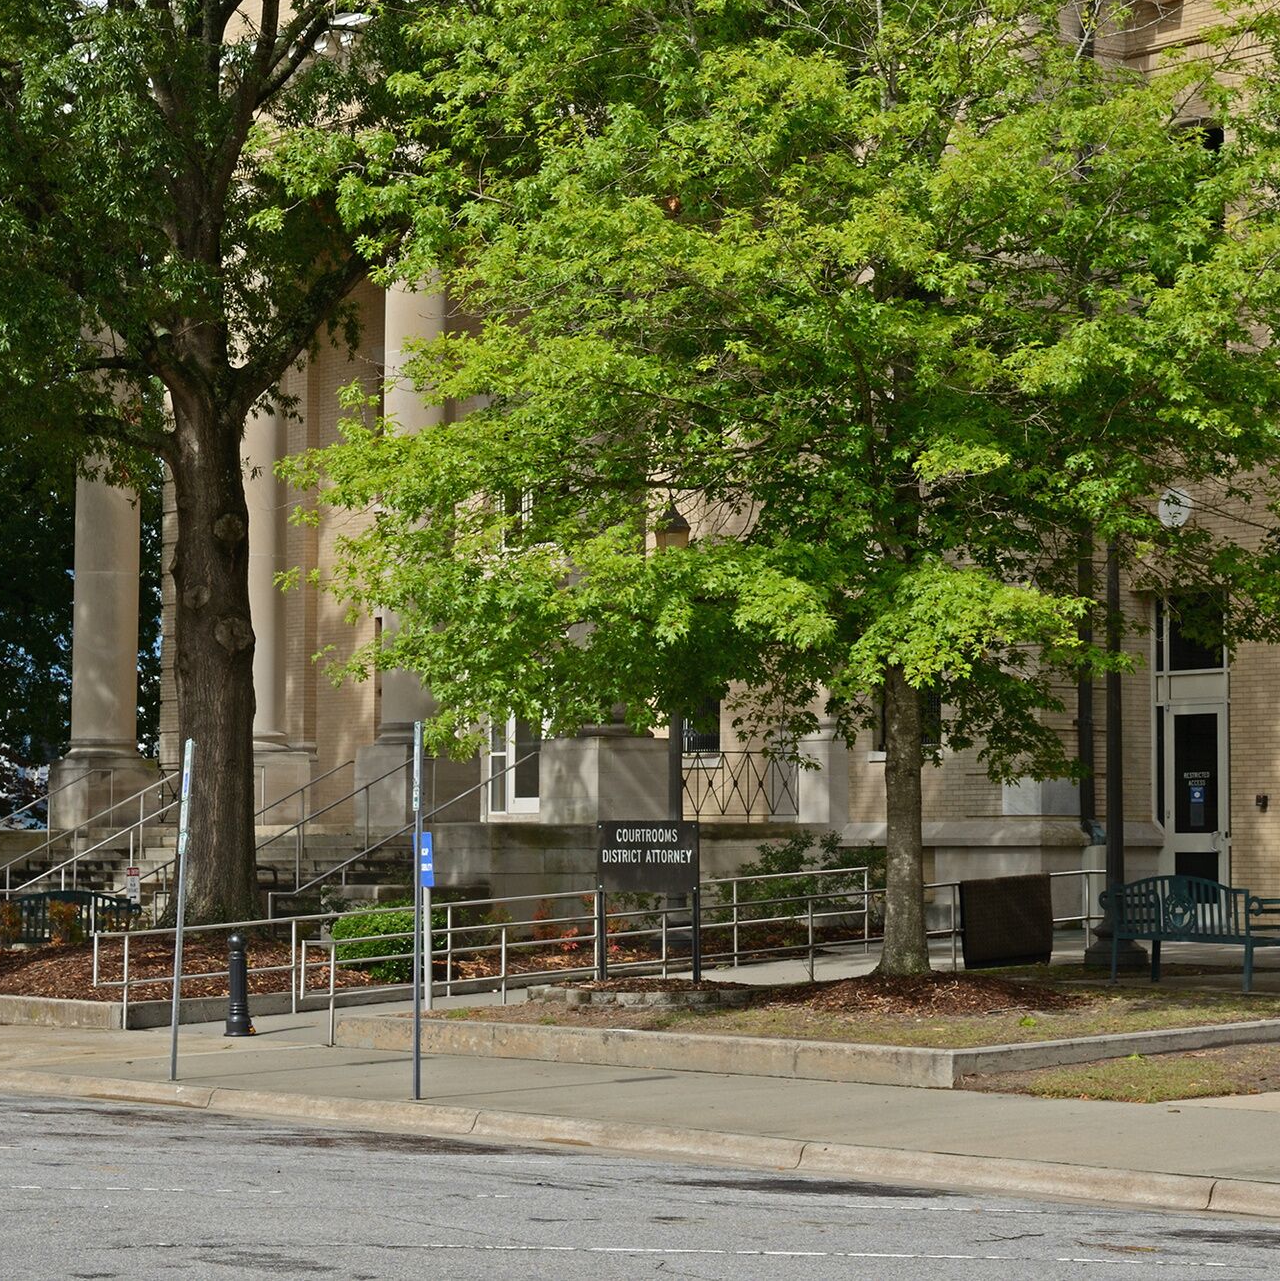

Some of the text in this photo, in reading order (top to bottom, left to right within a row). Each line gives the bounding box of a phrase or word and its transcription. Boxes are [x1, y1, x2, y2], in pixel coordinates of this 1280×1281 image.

[616, 828, 678, 842] COURTROOMS
[602, 849, 693, 863] DISTRICT ATTORNEY
